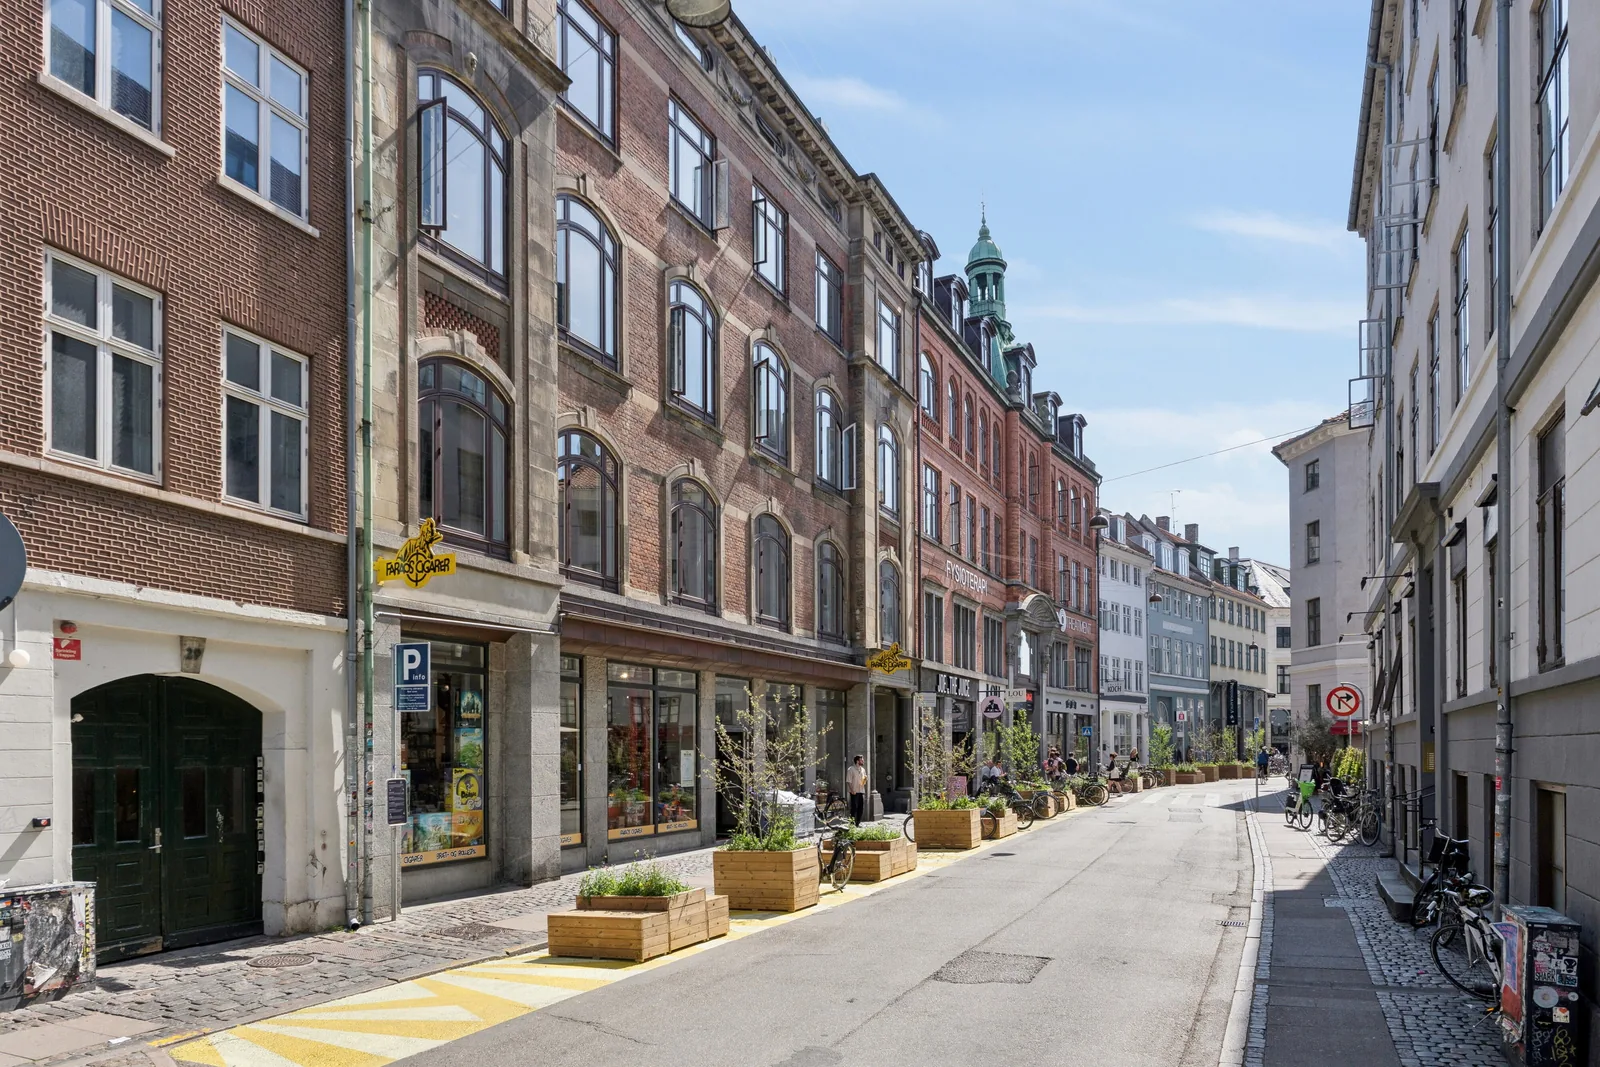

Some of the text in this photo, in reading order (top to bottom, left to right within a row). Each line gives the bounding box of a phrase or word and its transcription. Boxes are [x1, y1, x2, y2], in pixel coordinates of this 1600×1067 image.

[386, 558, 450, 576] FARAOS CIGARER
[946, 560, 988, 596] FYSIOTERAPI
[1066, 615, 1092, 635] TREATMENT
[403, 649, 421, 680] P
[404, 854, 423, 864] CIGARER
[1535, 972, 1556, 982] SHARK
